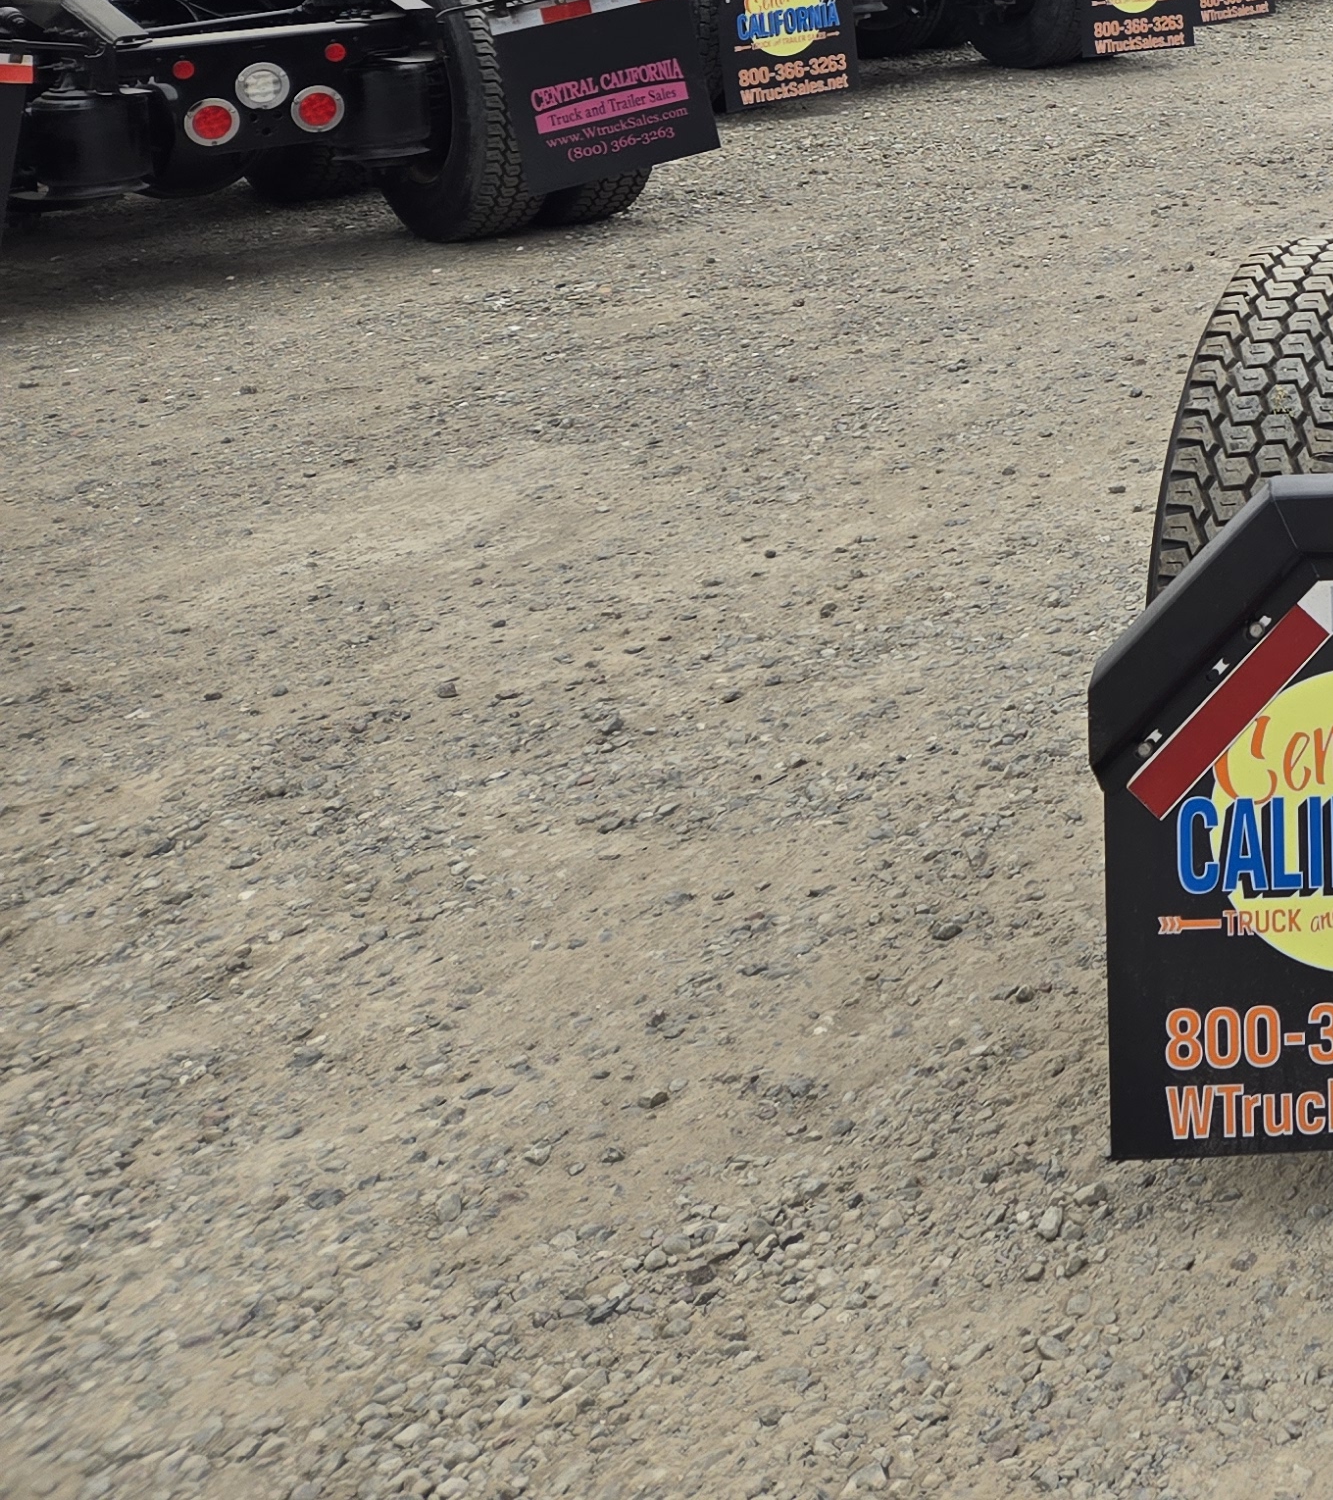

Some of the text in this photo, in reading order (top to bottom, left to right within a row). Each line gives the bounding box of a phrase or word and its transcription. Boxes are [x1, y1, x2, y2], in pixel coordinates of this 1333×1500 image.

[737, 2, 840, 41] CALIFORNIA
[1093, 14, 1184, 38] 800-366-3263
[1094, 32, 1185, 54] WTruckSales.net
[531, 58, 685, 112] CENTRAL CALIFORNIA
[738, 53, 847, 87] 800-366-3263
[740, 73, 849, 105] WTruckSales.net
[547, 88, 677, 127] Truck and Trailer Sales
[546, 107, 688, 148] www.WtruckSales.com
[567, 127, 676, 162] (800) 366-3263
[1223, 907, 1301, 936] TRUCK
